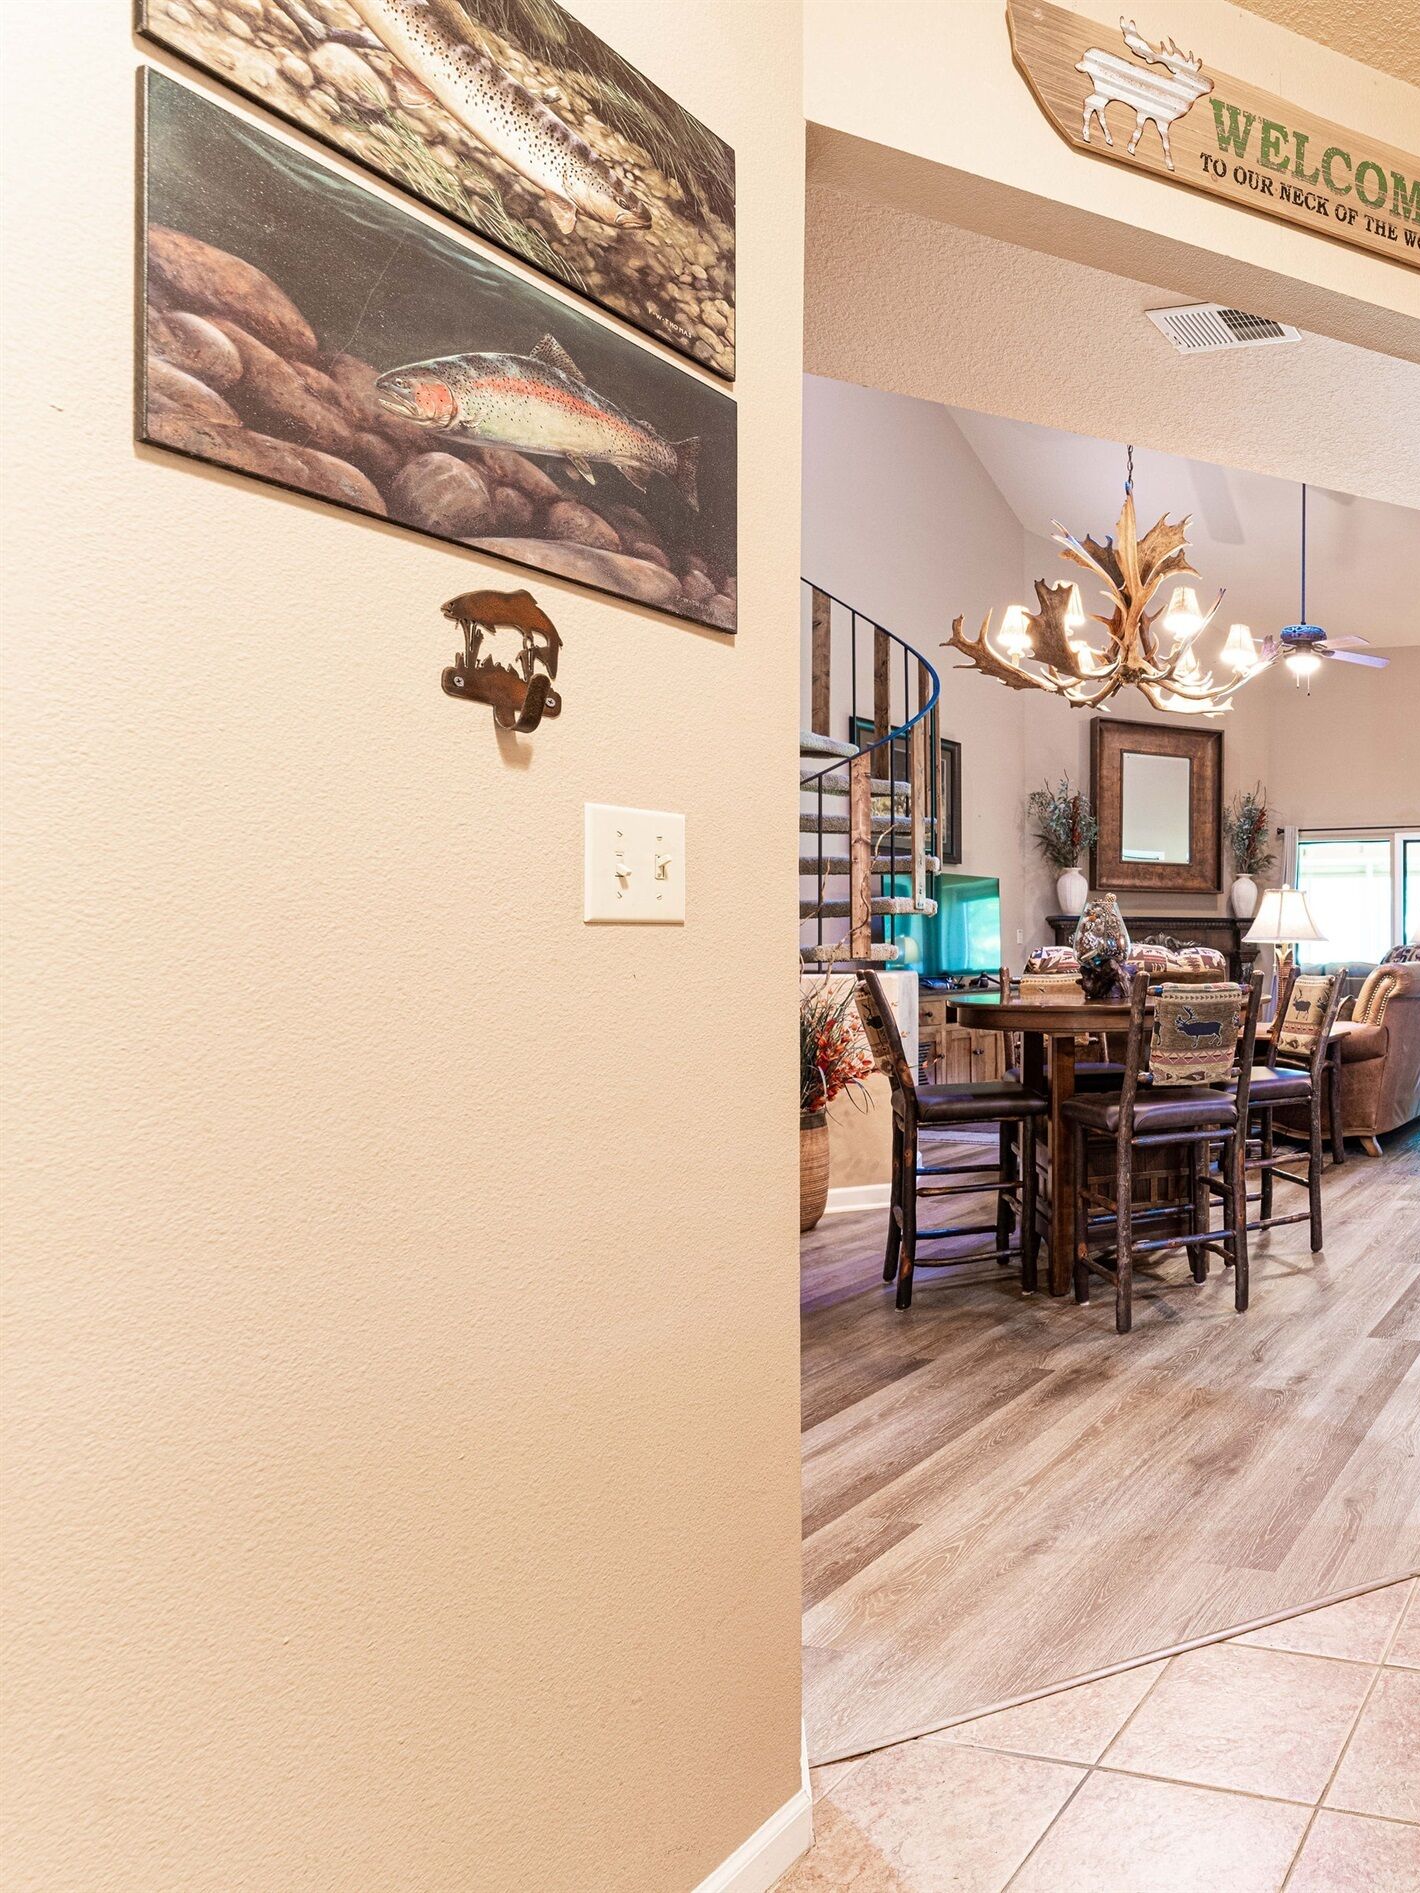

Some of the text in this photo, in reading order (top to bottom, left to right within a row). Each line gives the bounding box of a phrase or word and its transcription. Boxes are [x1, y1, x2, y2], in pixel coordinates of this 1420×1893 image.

[1200, 152, 1227, 178] TO
[1233, 165, 1274, 197] OUR
[1280, 182, 1330, 217] NECK
[1335, 203, 1358, 226] OF
[1364, 214, 1399, 242] THE
